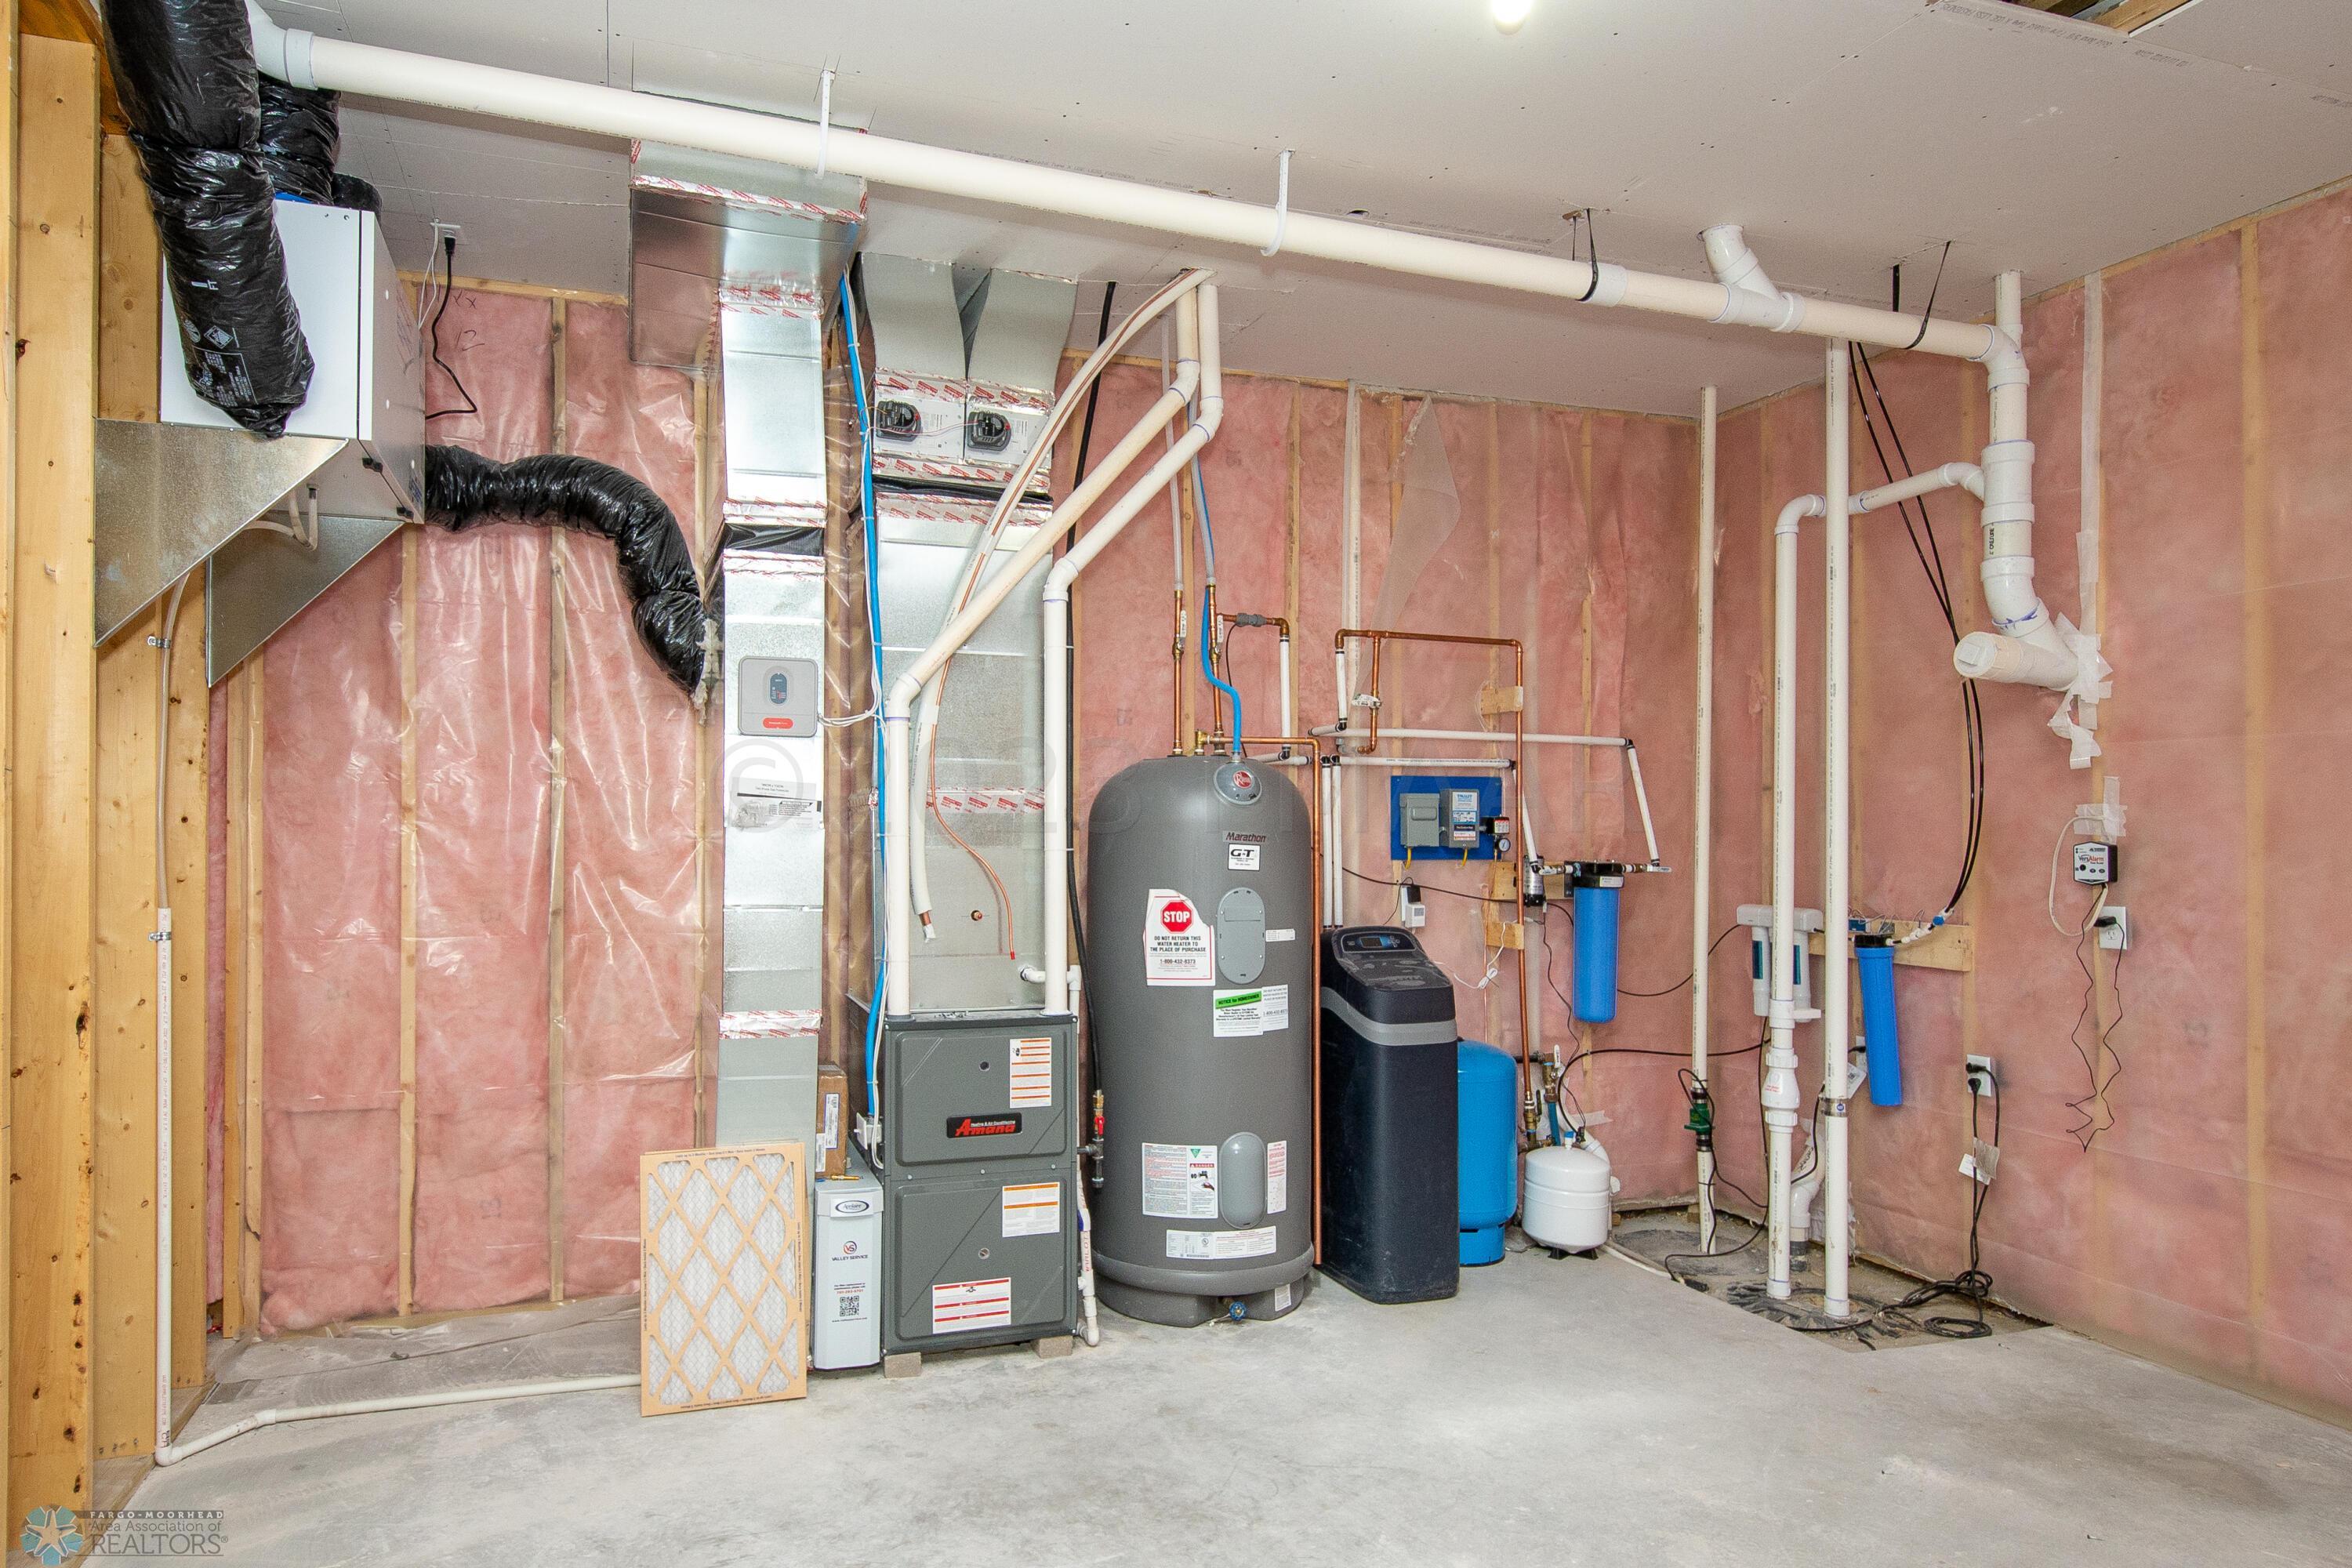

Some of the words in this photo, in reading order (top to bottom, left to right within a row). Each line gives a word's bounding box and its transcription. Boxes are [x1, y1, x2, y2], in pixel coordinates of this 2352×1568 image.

[1226, 832, 1266, 842] Marathon
[1164, 911, 1190, 922] STOP
[955, 1118, 1016, 1136] Amana
